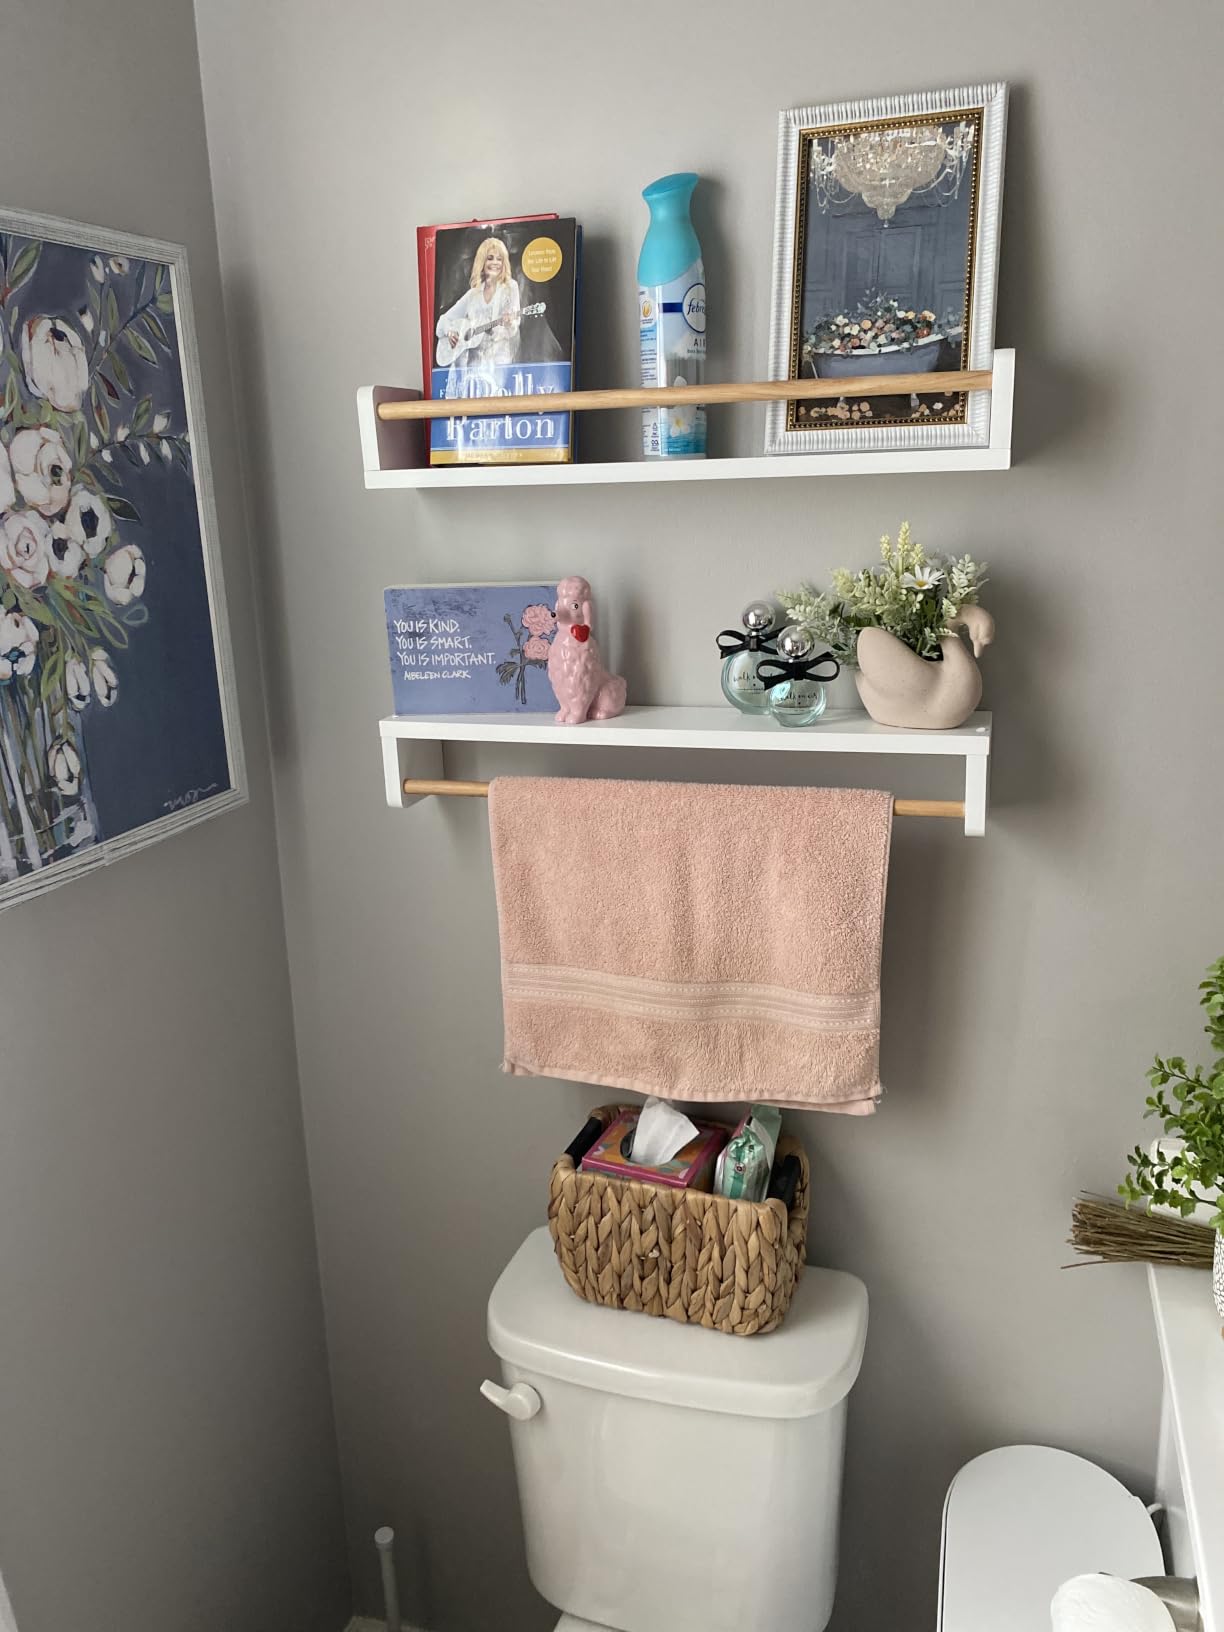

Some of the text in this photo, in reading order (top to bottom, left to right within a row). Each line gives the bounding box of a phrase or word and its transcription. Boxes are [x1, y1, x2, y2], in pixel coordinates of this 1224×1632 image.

[394, 618, 460, 633] YOU IS KIND.
[395, 635, 472, 650] YOU IS SMART.
[397, 651, 497, 666] YOU IS IMPORTANT.
[441, 670, 472, 679] CLARK
